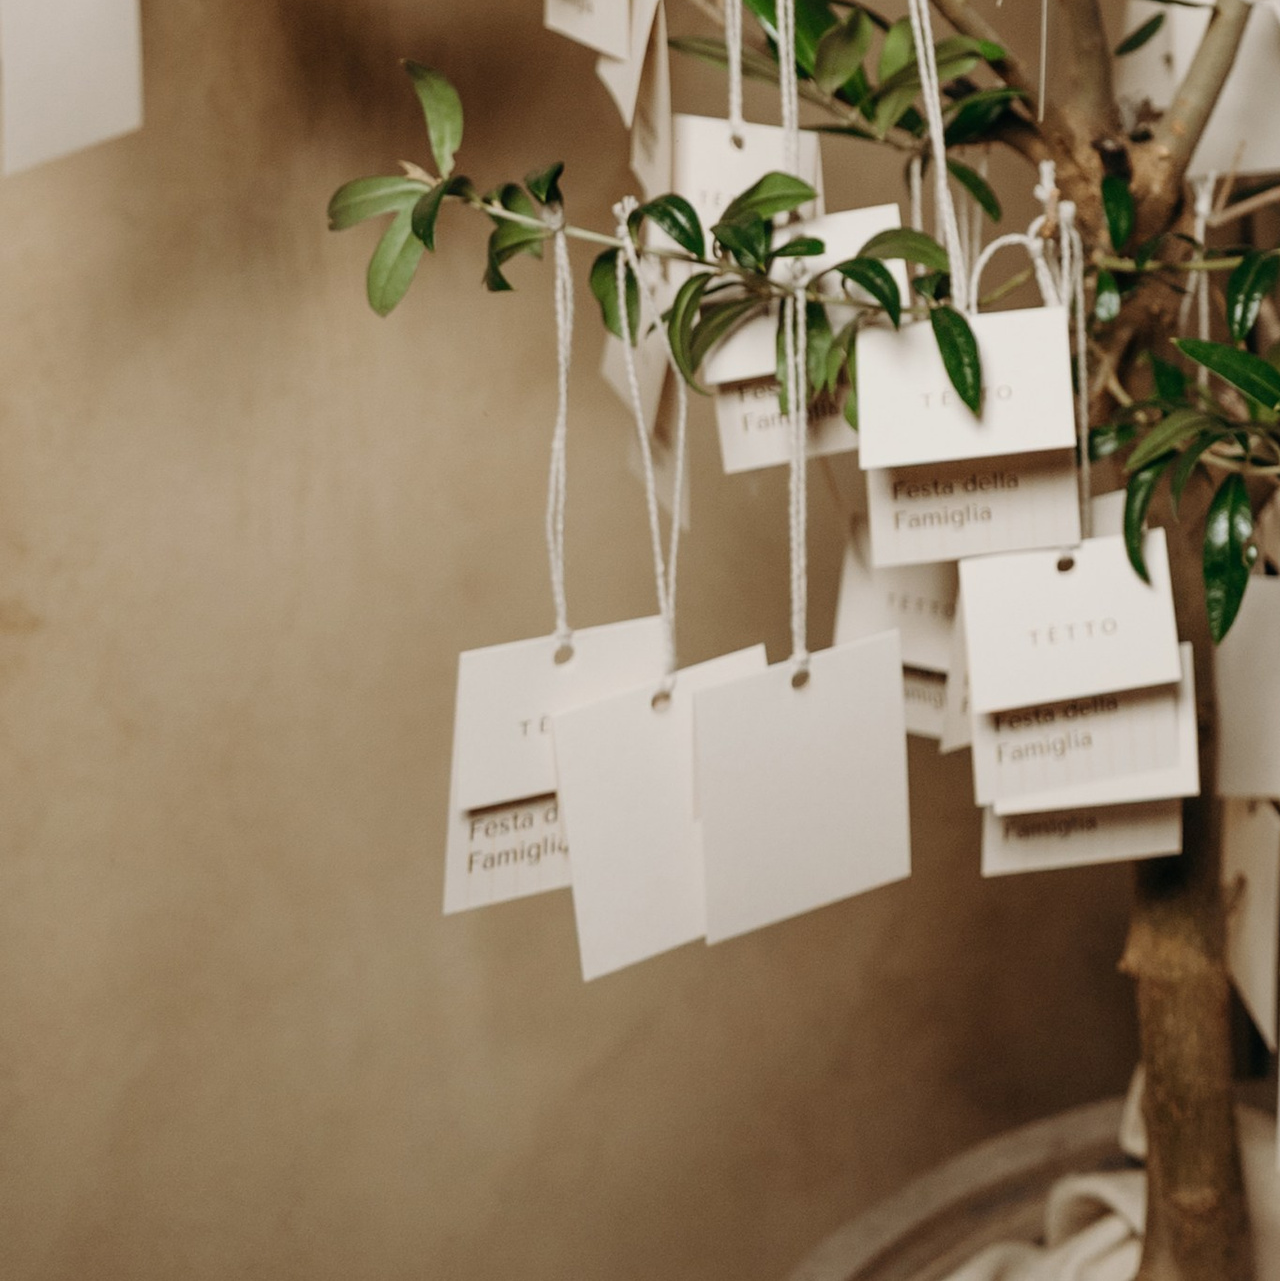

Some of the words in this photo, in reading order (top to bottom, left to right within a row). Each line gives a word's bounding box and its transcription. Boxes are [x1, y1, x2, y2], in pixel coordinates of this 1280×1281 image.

[892, 479, 954, 500] Festa
[963, 471, 1019, 492] della
[894, 503, 992, 530] Famiglia
[469, 812, 534, 842] Festa
